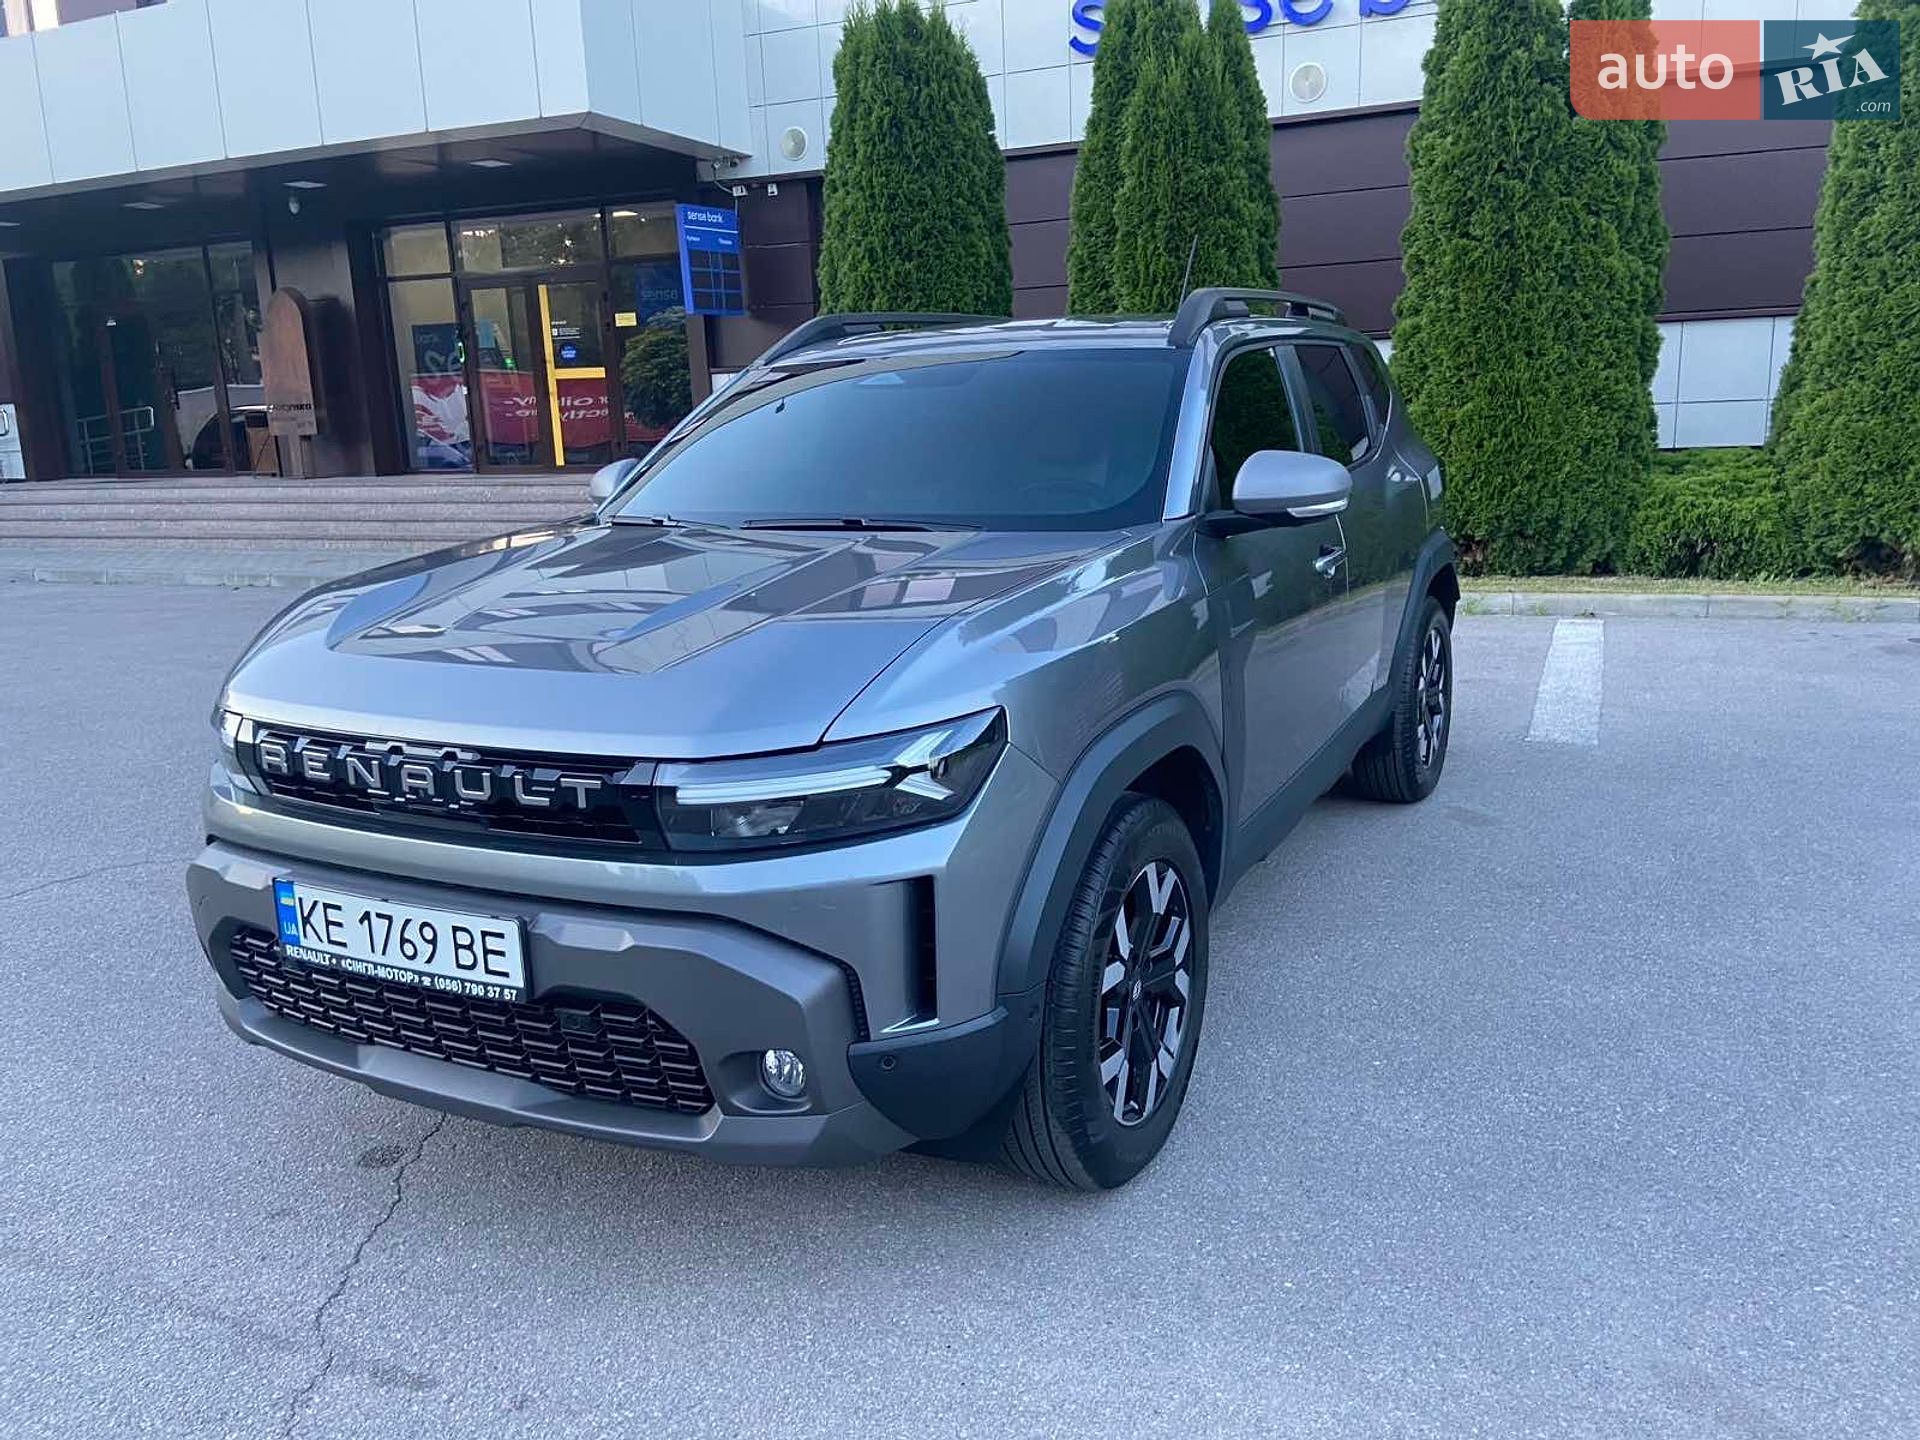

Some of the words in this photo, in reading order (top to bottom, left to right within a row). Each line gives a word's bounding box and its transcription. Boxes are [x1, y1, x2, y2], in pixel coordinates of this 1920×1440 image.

[259, 740, 602, 809] RENAULT
[284, 921, 299, 937] UA
[298, 897, 348, 949] KE
[358, 909, 439, 964] 1769
[452, 925, 510, 978] BE
[286, 944, 331, 966] RENAULT
[487, 986, 500, 999] 37
[503, 988, 517, 1001] 57
